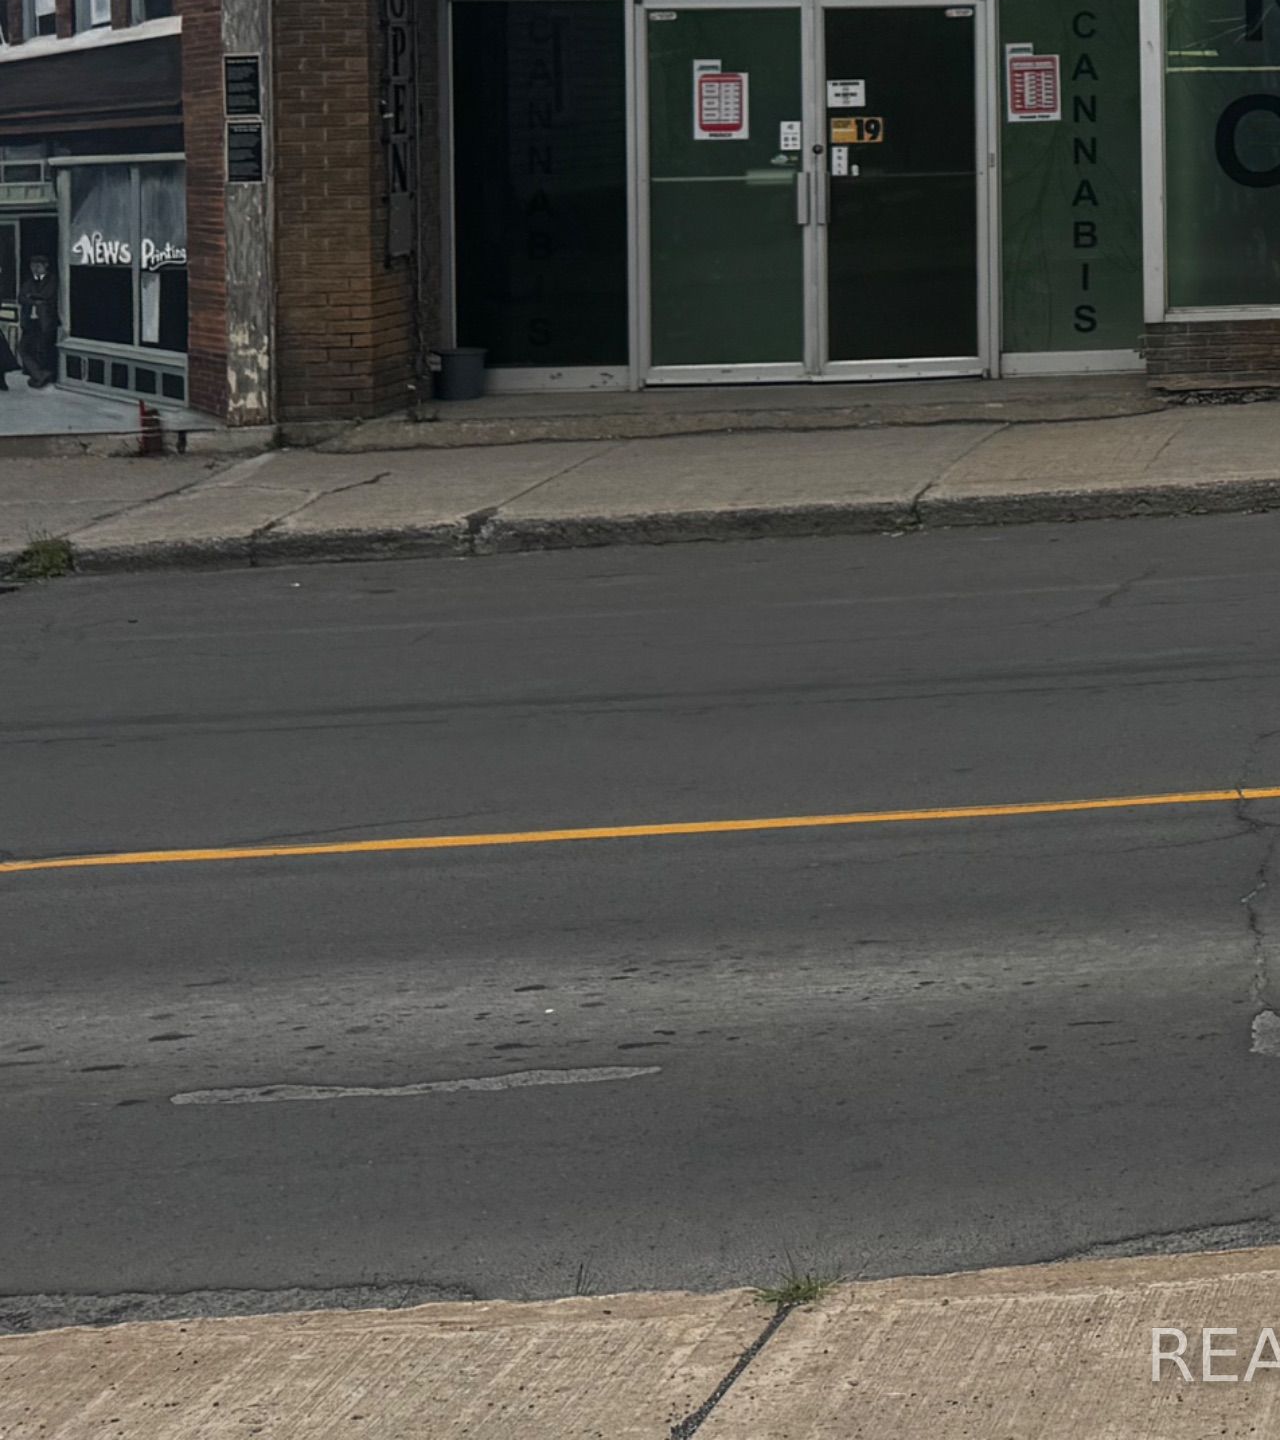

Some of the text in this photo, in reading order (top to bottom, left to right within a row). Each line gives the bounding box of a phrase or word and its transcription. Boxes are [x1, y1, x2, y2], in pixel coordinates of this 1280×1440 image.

[855, 118, 881, 140] 19
[1072, 11, 1098, 335] CANNABIS
[72, 231, 132, 265] NEWS
